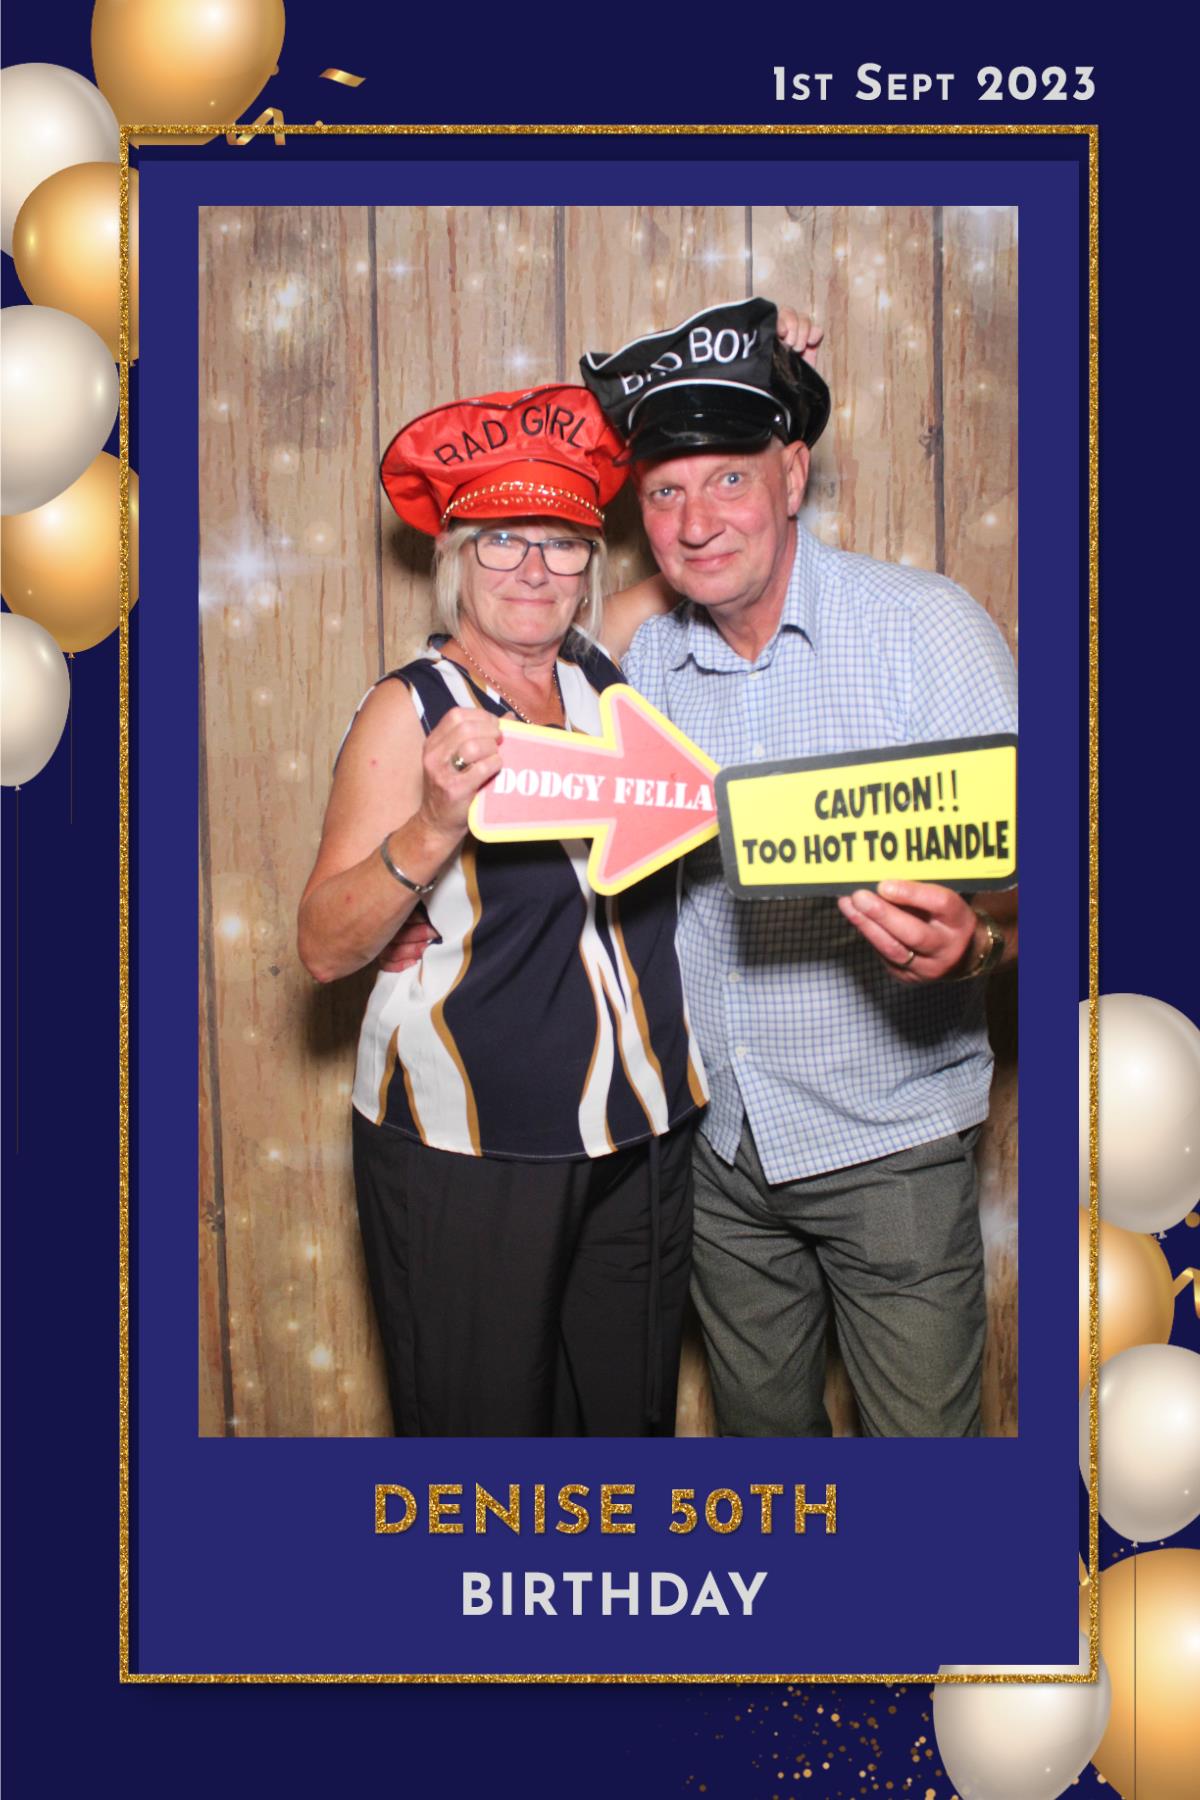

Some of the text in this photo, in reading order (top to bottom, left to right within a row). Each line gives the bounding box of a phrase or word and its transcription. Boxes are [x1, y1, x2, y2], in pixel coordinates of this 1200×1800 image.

[619, 326, 757, 395] BD BOY
[433, 393, 586, 466] BAD GIRL
[493, 767, 606, 802] DODGY
[815, 769, 960, 820] CAUTION!!
[743, 820, 1009, 864] TOO HOT TO HANDLE
